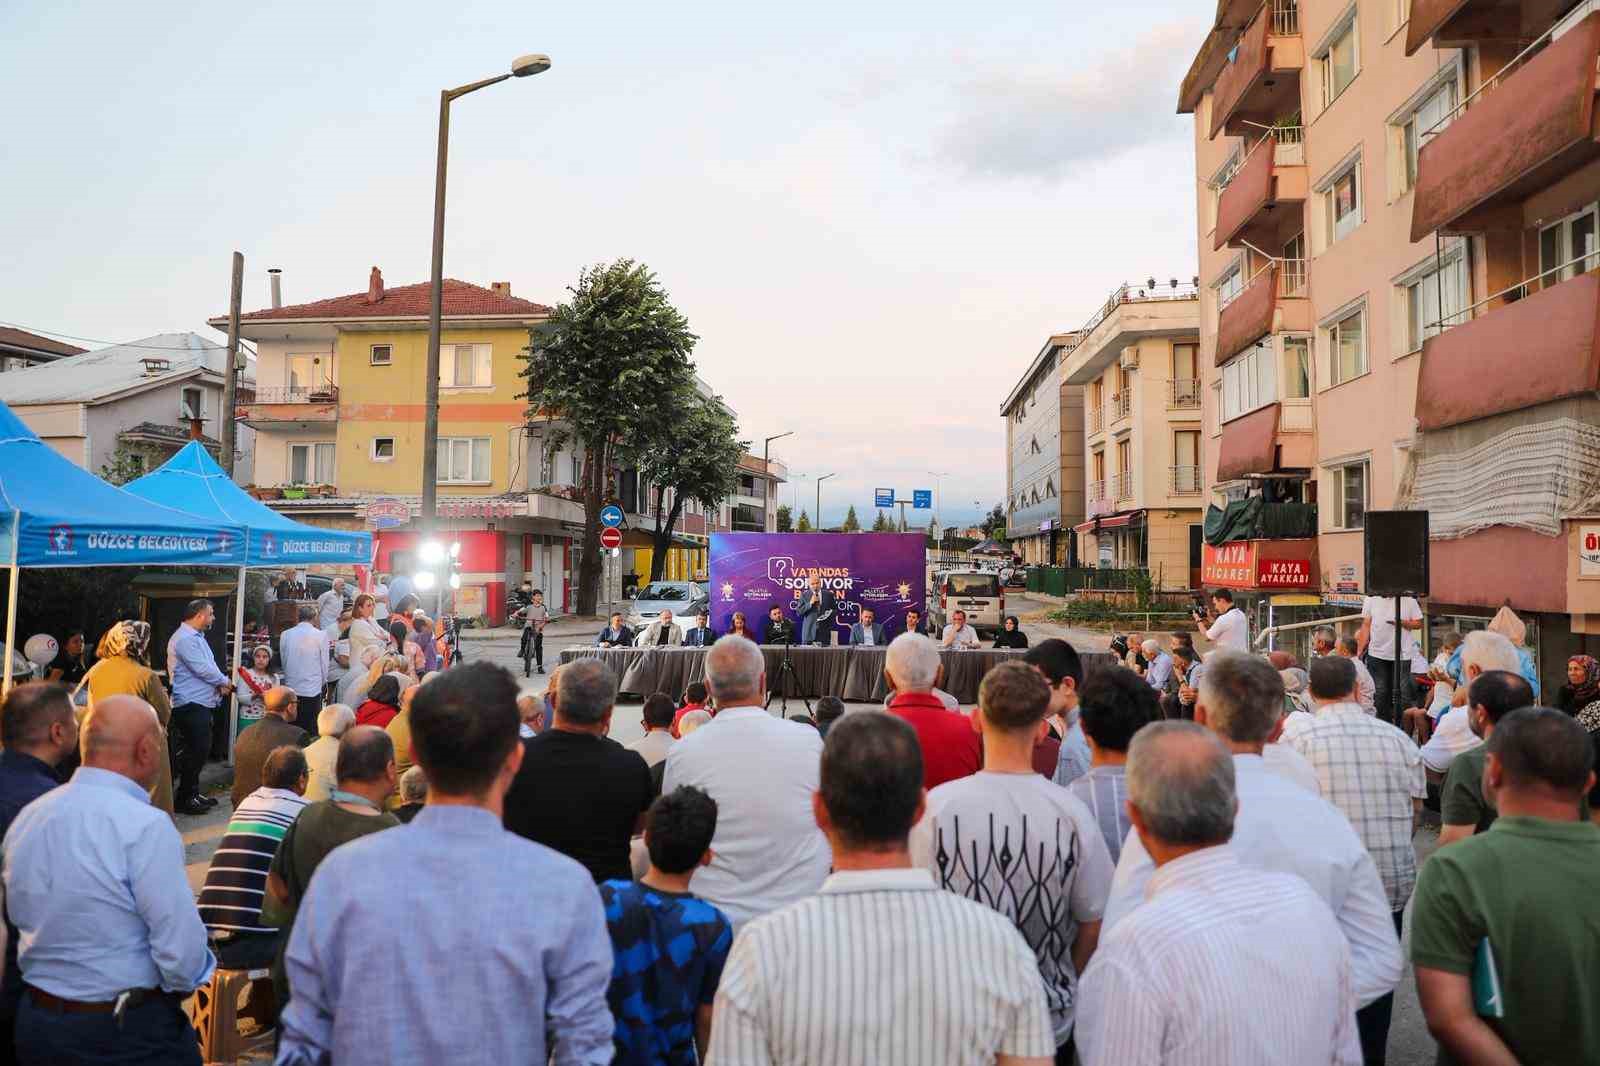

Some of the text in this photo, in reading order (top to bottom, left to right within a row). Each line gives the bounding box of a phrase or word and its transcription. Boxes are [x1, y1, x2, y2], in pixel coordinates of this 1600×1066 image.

[87, 532, 136, 549] DÜZCE
[282, 539, 309, 553] DÜZCE
[1215, 545, 1247, 564] KAYA
[1271, 563, 1301, 574] KAYA
[784, 577, 853, 590] SOYOR
[1260, 573, 1310, 584] AYAKKABI
